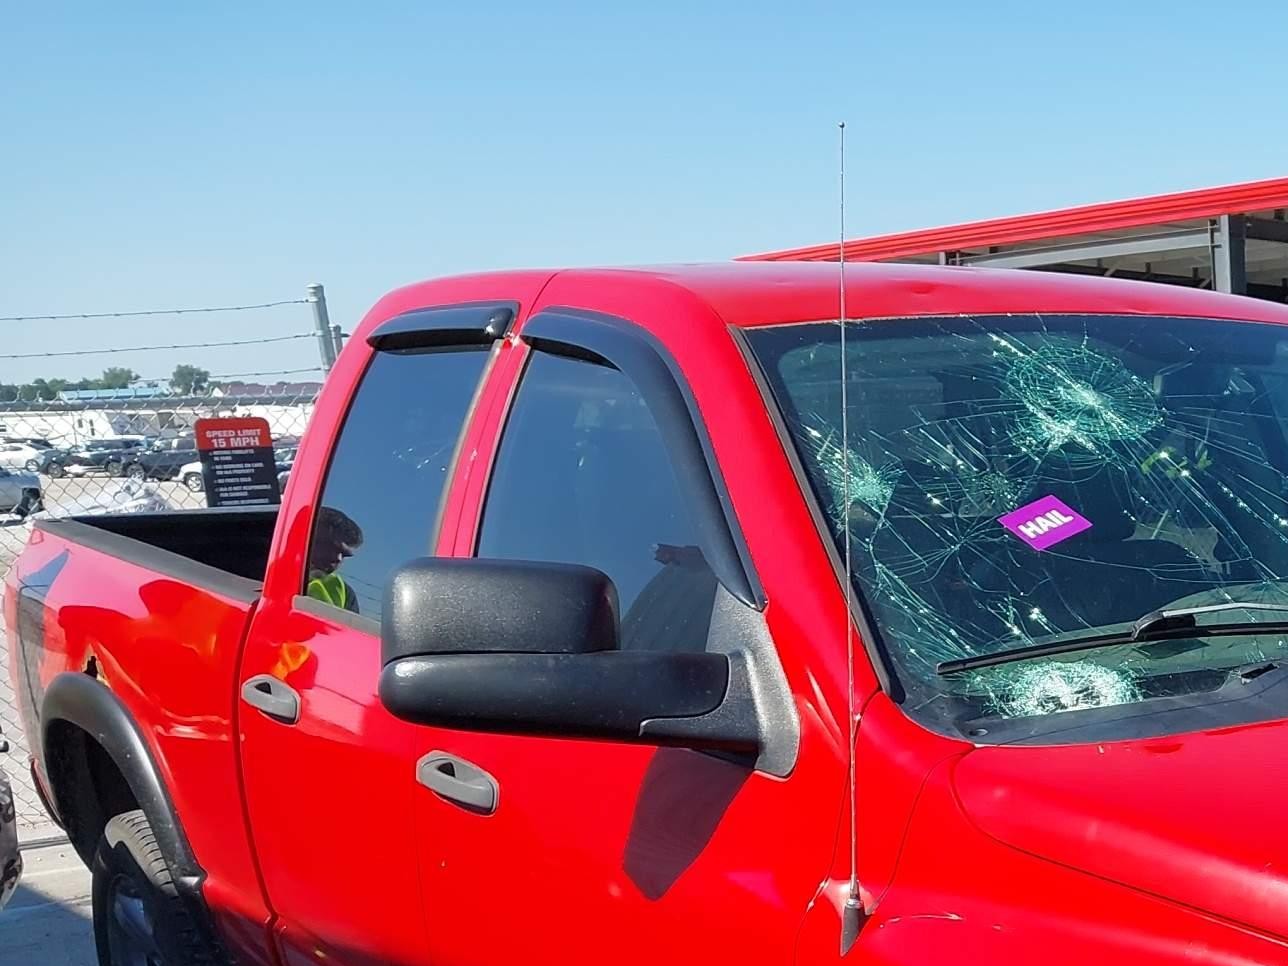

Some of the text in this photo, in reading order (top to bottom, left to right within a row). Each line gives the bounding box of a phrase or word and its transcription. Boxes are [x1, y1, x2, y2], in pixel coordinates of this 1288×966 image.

[205, 429, 261, 438] SPEED LIMIT
[211, 437, 260, 448] 15 MPH
[1018, 509, 1074, 539] HAIL
